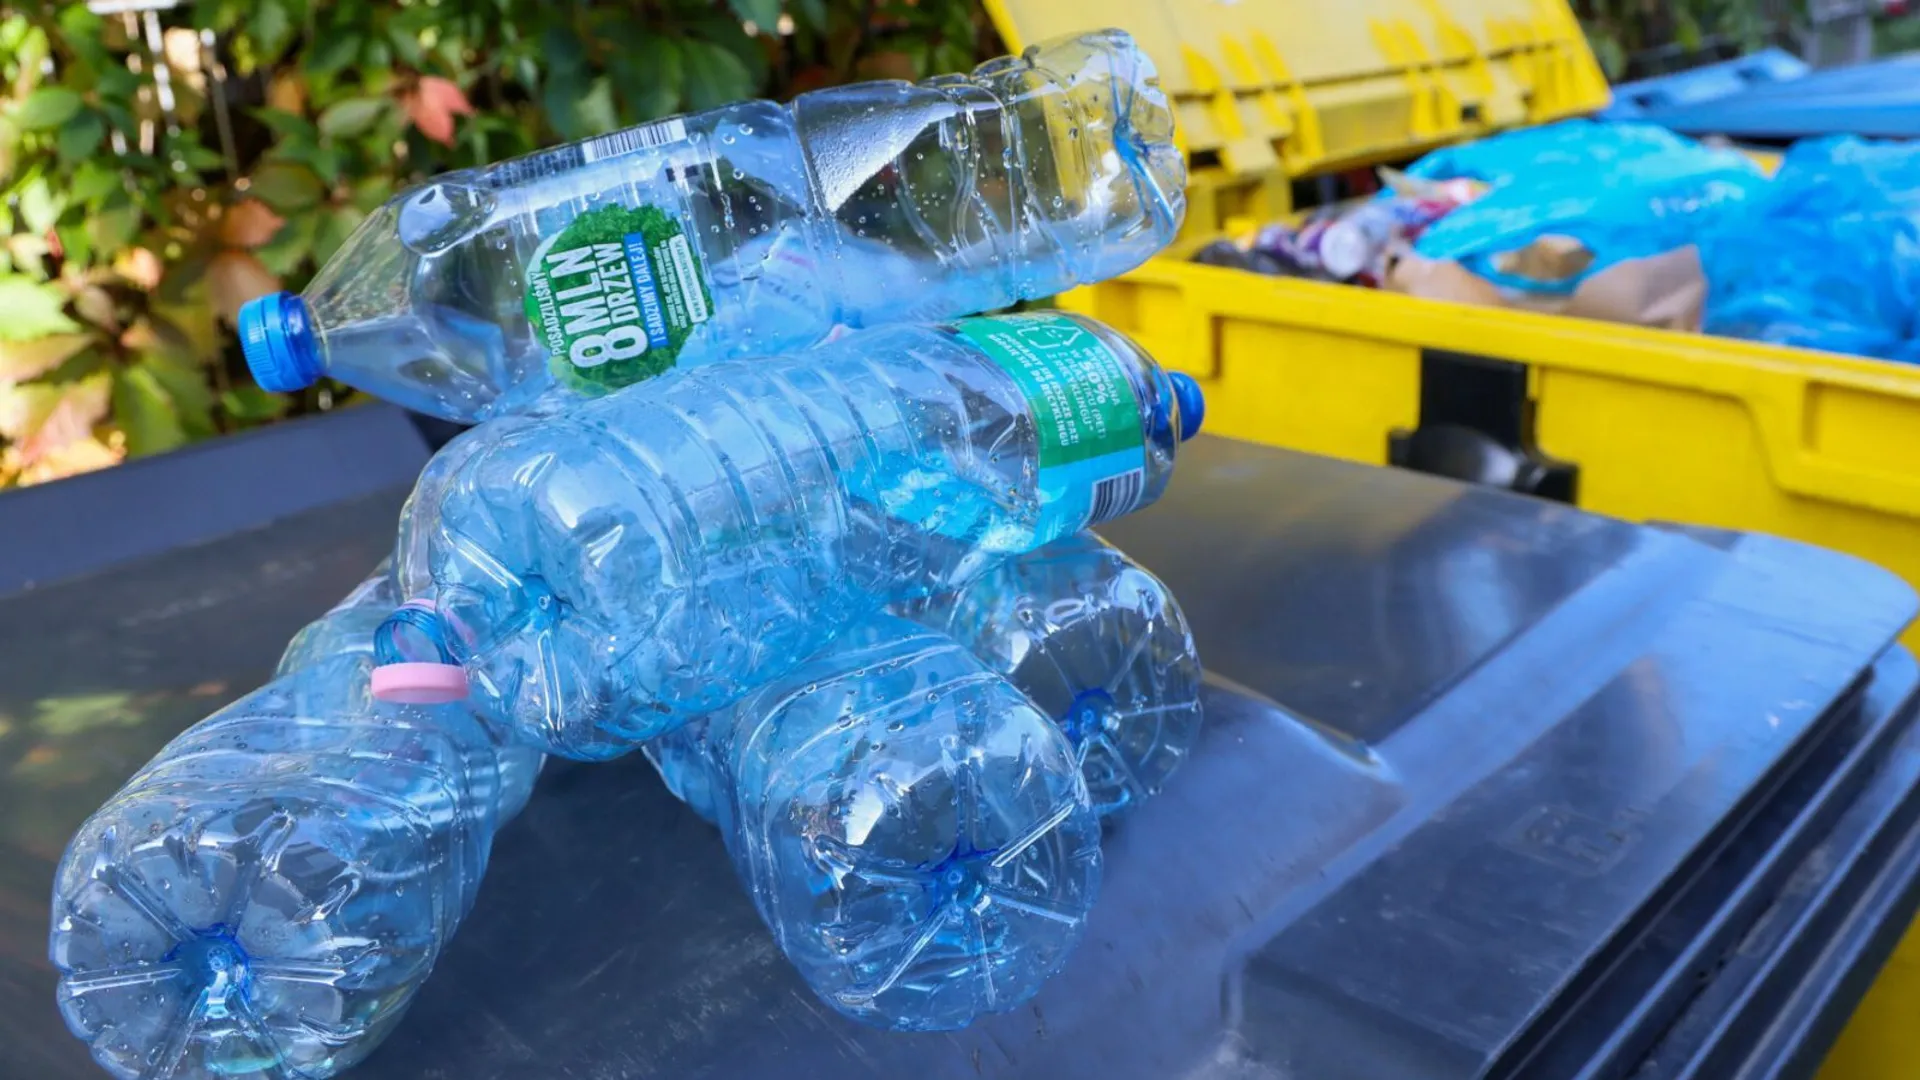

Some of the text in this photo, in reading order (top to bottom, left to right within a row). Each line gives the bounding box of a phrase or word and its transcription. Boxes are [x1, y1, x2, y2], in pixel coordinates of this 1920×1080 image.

[592, 242, 640, 324] DRZEW
[627, 242, 652, 284] DALEJ!
[529, 272, 567, 356] POSADZILIŚMY
[546, 245, 648, 368] 8 MLN
[638, 285, 664, 335] SADZIMY
[1064, 358, 1097, 406] PLASTIKU
[1078, 361, 1109, 404] 50%
[1082, 347, 1121, 406] WYKONANA
[1040, 383, 1070, 446] RECYKLINGU
